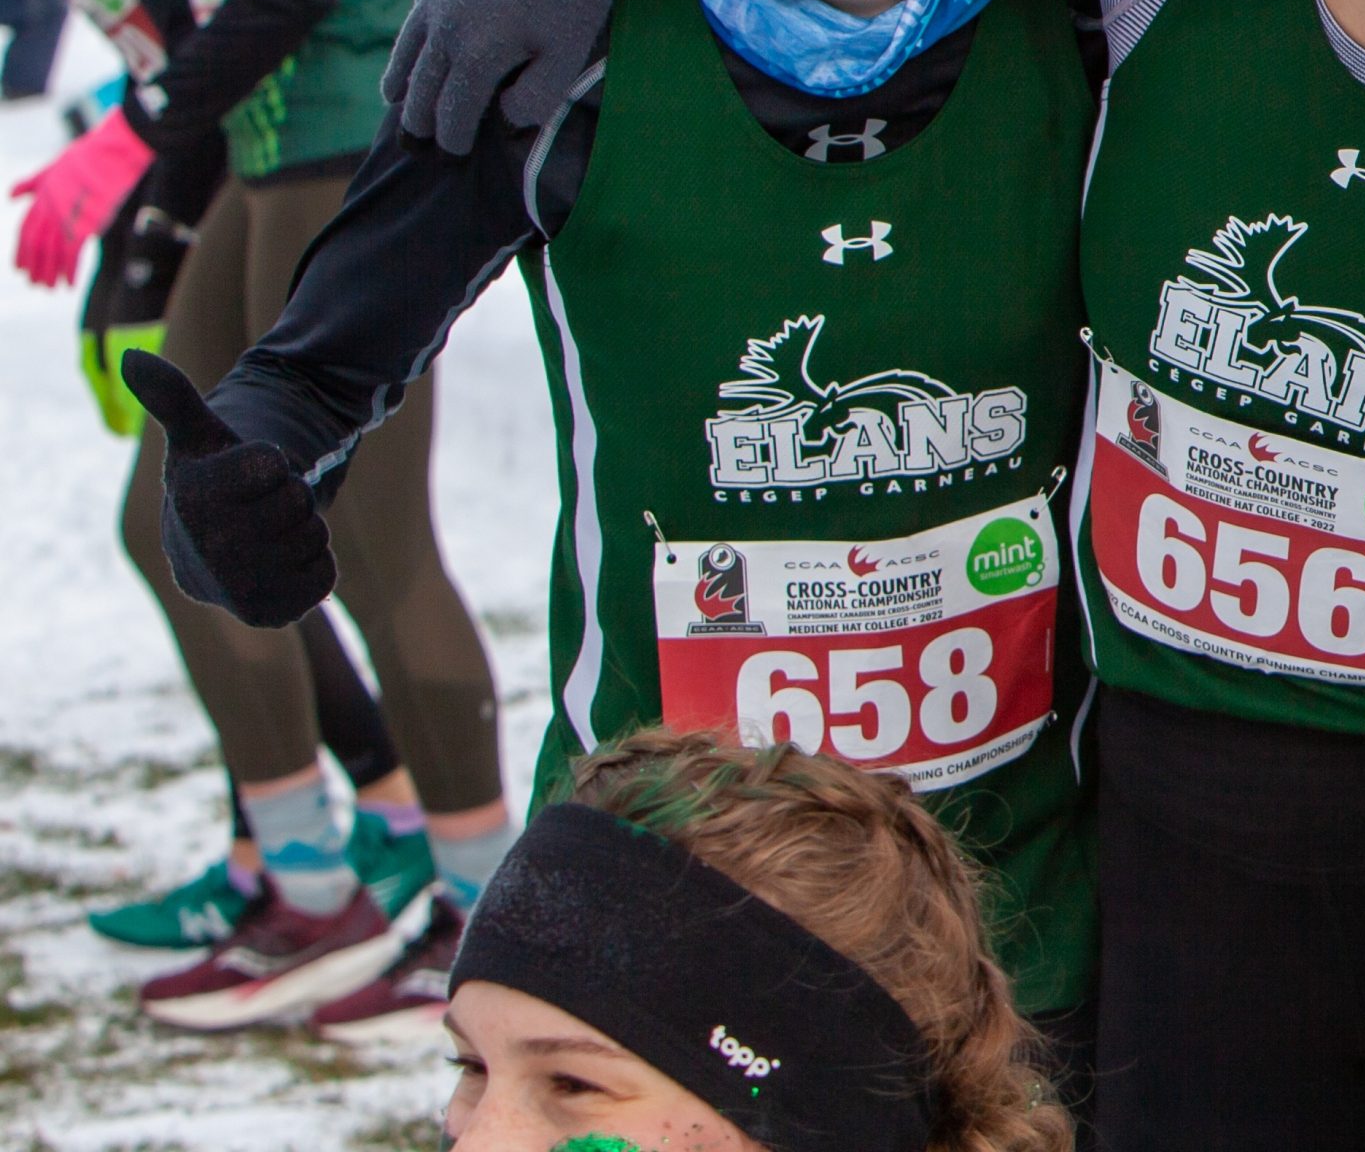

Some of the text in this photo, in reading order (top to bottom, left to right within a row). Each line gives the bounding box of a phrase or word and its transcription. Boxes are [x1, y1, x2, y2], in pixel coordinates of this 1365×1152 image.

[1148, 359, 1252, 406] CÉGEP
[705, 386, 1027, 488] ELANS
[1189, 426, 1339, 477] CCAA ACSC
[714, 456, 1022, 502] CÉGEP GARNEAU
[1187, 460, 1336, 511] NATIONAL CHAMPIONSHIP
[1188, 445, 1339, 500] CROSS-COUNTRY
[1185, 484, 1335, 533] MEDICINE HAT COLLEGE 2022
[1280, 500, 1336, 520] CROSS-COUNTRY
[784, 550, 940, 569] CCAA ACSC
[974, 536, 1036, 572] mint
[786, 569, 943, 598] CROSS-COUNTRY
[787, 586, 942, 610] NATIONAL CHAMPIONSHIP
[788, 610, 943, 634] MEDICINE HAT COLLEGE 2022
[1120, 602, 1149, 625] CCAA
[1152, 620, 1190, 644] CROSS
[1194, 638, 1253, 663] COUNTRY
[737, 627, 998, 760] 658
[947, 730, 1034, 775] CHAMPIONSHIPS
[710, 1025, 770, 1077] topp
